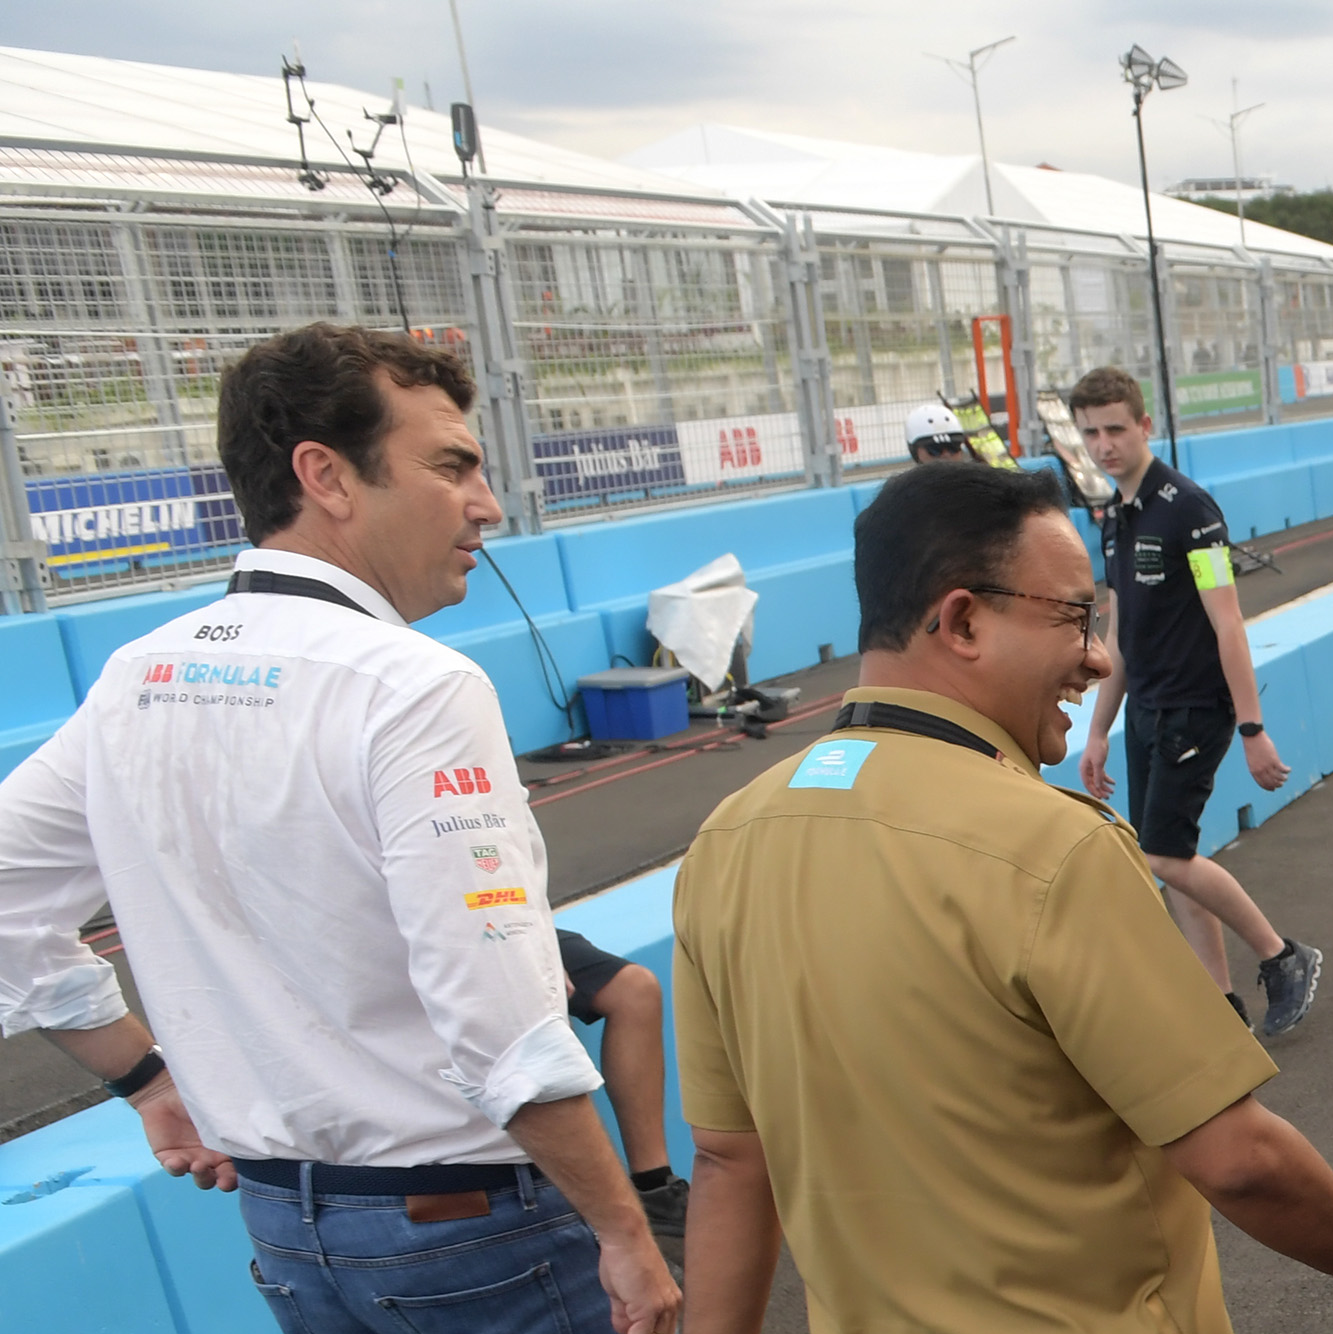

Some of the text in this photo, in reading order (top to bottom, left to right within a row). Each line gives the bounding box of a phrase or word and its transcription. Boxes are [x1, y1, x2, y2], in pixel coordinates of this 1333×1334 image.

[719, 427, 761, 469] ABB
[572, 438, 660, 485] Julius Bär
[31, 502, 195, 545] MICHELIN
[193, 624, 243, 642] BOSS
[143, 664, 174, 685] ABB
[153, 693, 188, 704] WORLD
[434, 767, 491, 798] ABB
[431, 813, 507, 838] Julius Bär
[475, 848, 497, 859] TAG
[476, 890, 520, 906] DHL
